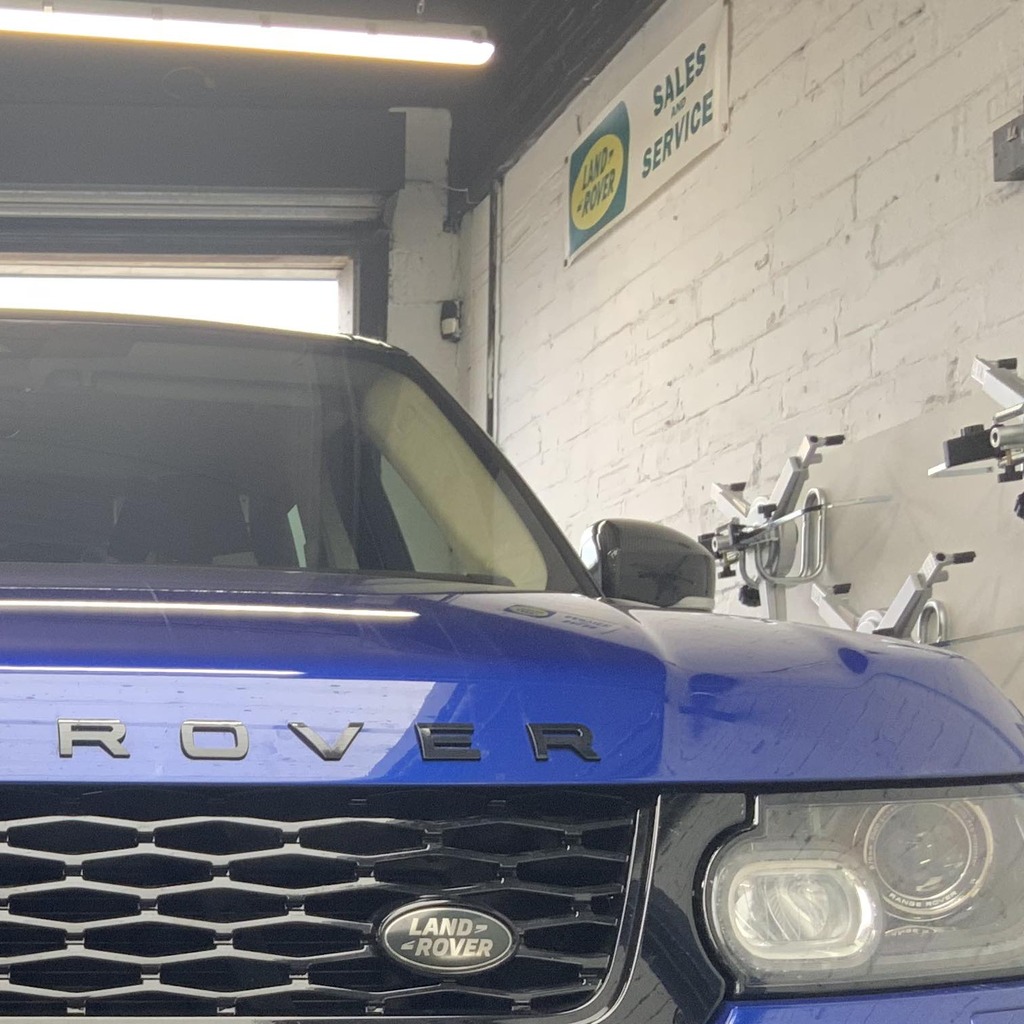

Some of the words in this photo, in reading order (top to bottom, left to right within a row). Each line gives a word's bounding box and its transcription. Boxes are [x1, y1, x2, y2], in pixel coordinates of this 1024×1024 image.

[653, 43, 706, 117] SALES
[671, 96, 687, 118] AND
[642, 89, 714, 179] SERVICE
[56, 717, 602, 762] ROVER
[888, 891, 922, 908] RANGE
[925, 890, 958, 907] ROVER
[409, 917, 473, 936] LAND
[415, 937, 494, 957] ROVER
